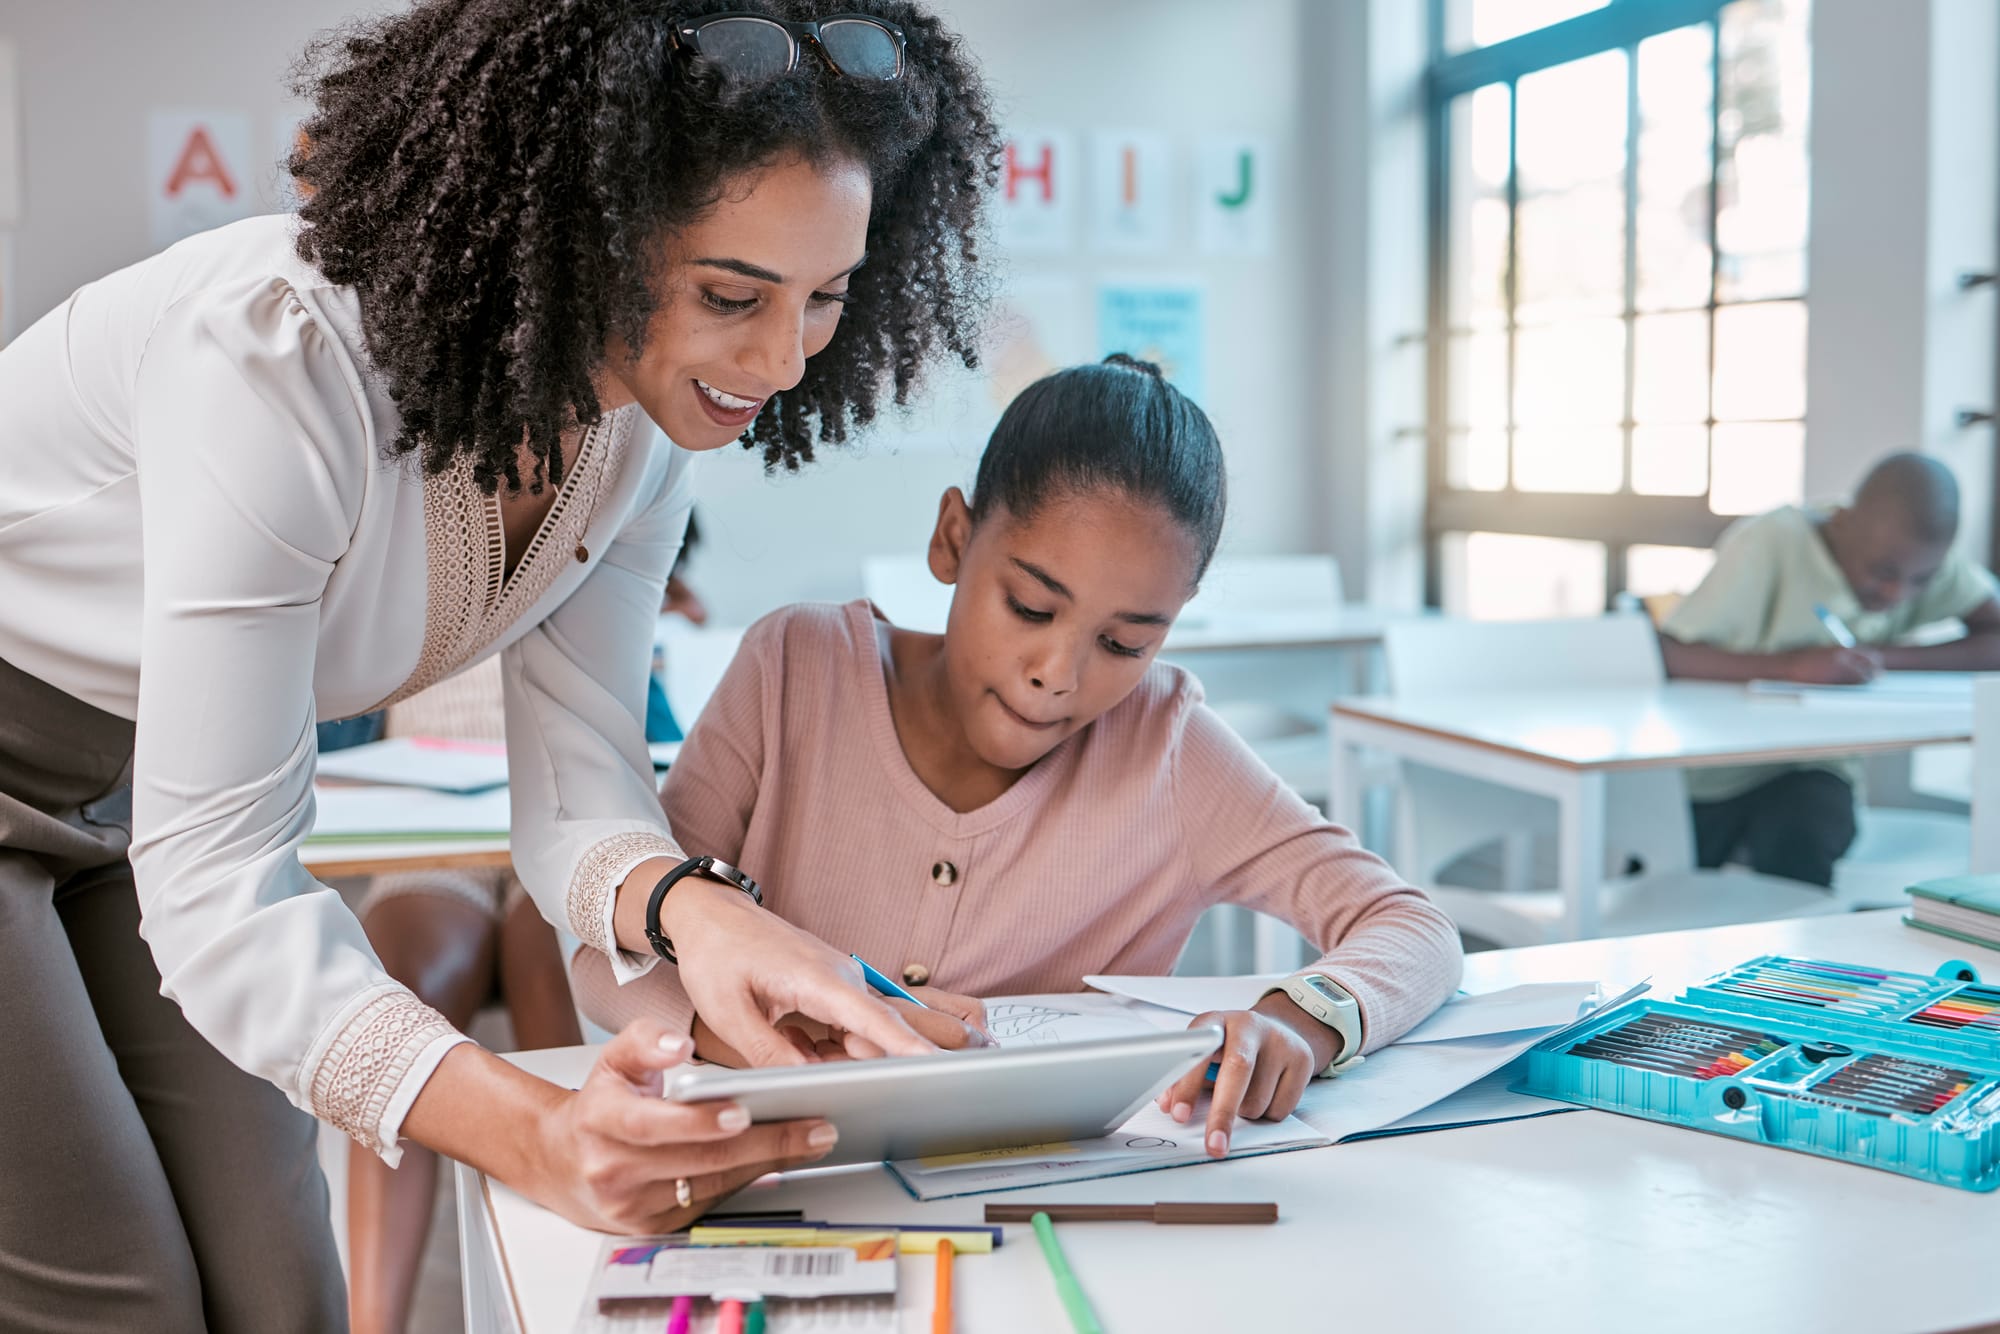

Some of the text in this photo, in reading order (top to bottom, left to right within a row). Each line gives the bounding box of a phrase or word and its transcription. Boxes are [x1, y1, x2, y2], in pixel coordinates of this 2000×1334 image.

[165, 123, 237, 199] A
[1005, 143, 1054, 203] H
[1122, 147, 1136, 207] I
[1214, 148, 1252, 208] J
